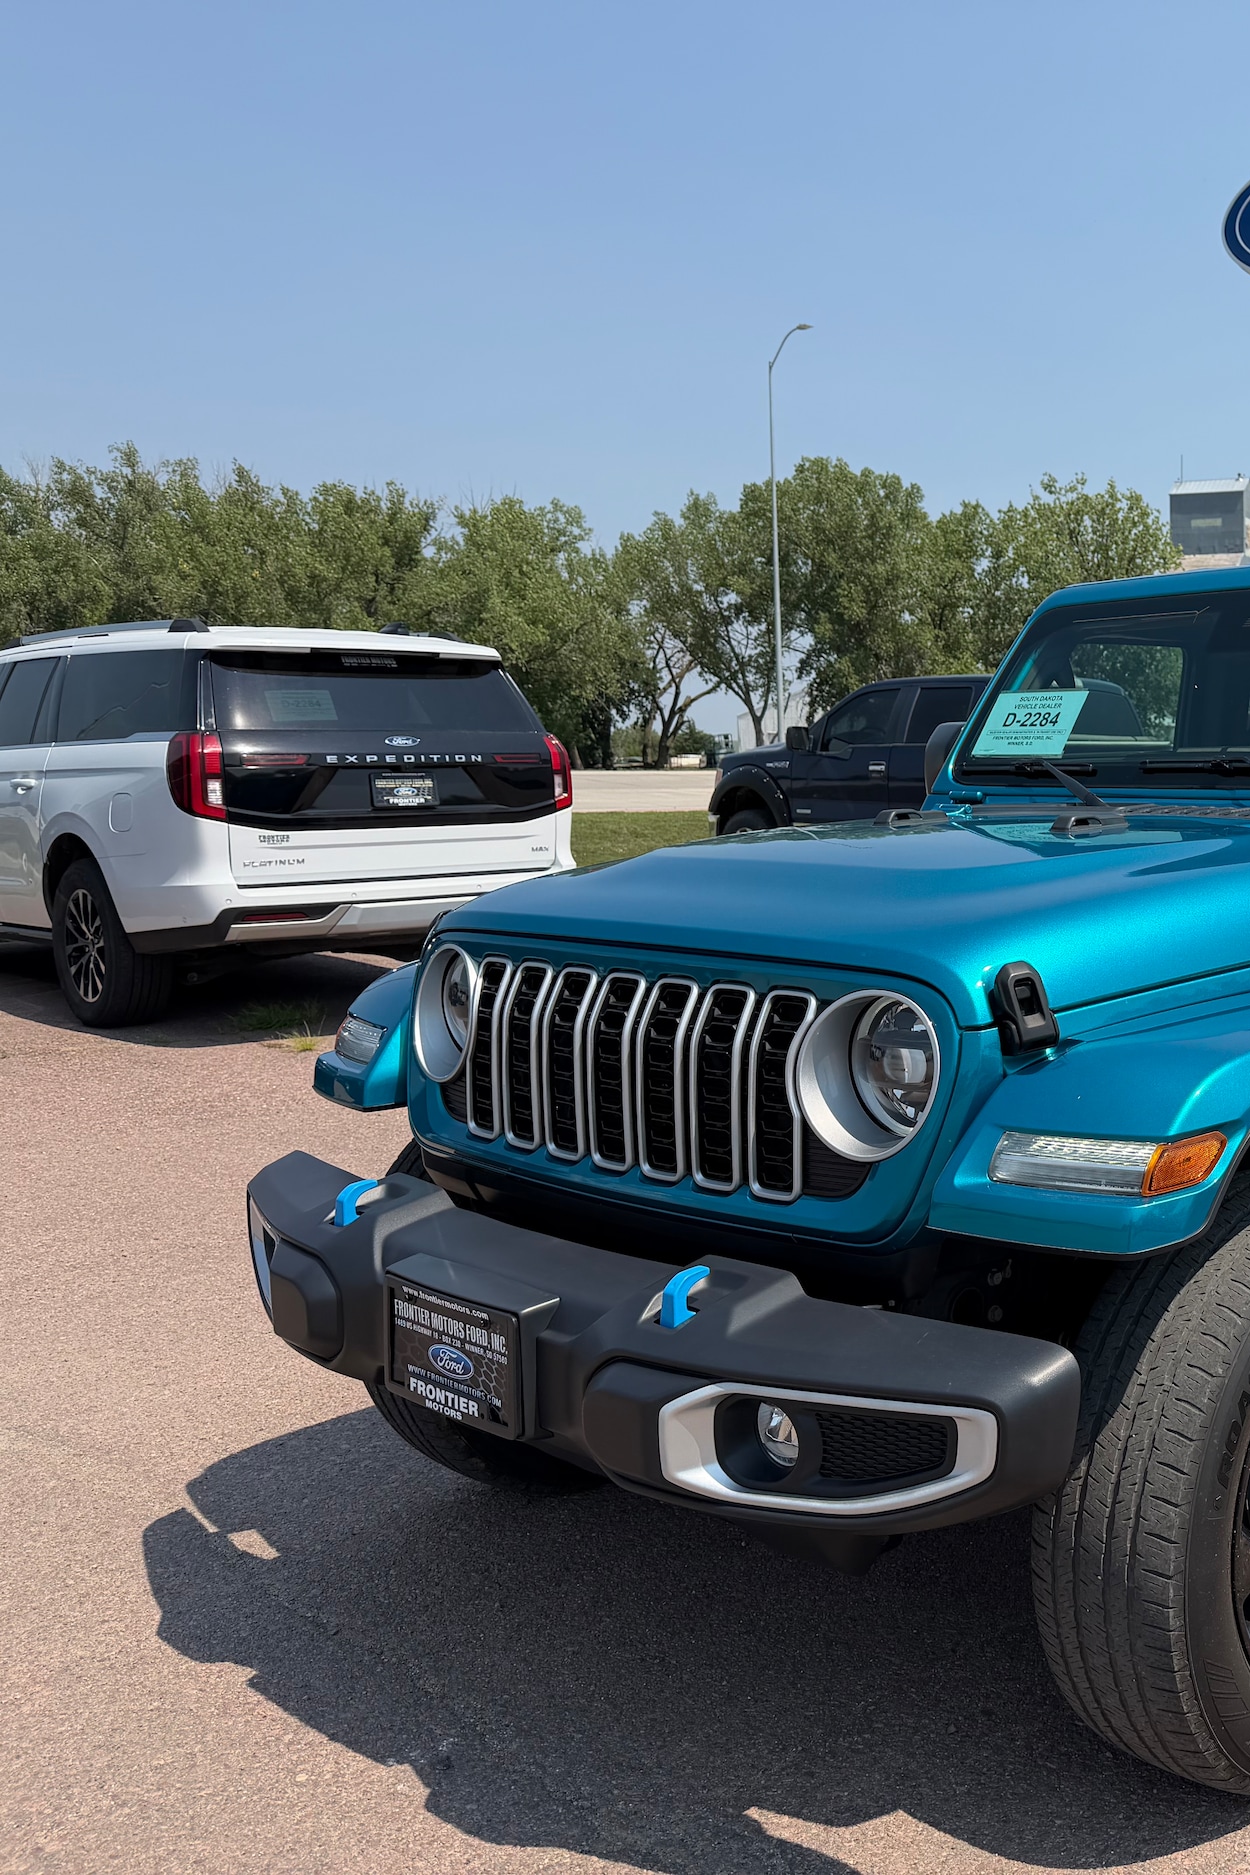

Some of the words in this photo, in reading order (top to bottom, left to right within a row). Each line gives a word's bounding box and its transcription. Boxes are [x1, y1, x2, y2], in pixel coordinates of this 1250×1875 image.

[1002, 711, 1061, 727] D-2284
[325, 754, 483, 764] EXPEDITION
[243, 858, 305, 868] PLATINUM
[402, 1285, 490, 1320] www.frontiermotors.com
[394, 1299, 430, 1327] FRONTIER
[431, 1311, 465, 1339] MOTORS
[466, 1324, 491, 1349] FORD,
[491, 1332, 508, 1355] INC.
[409, 1377, 479, 1418] FRONTIER
[425, 1399, 463, 1420] MOTORS
